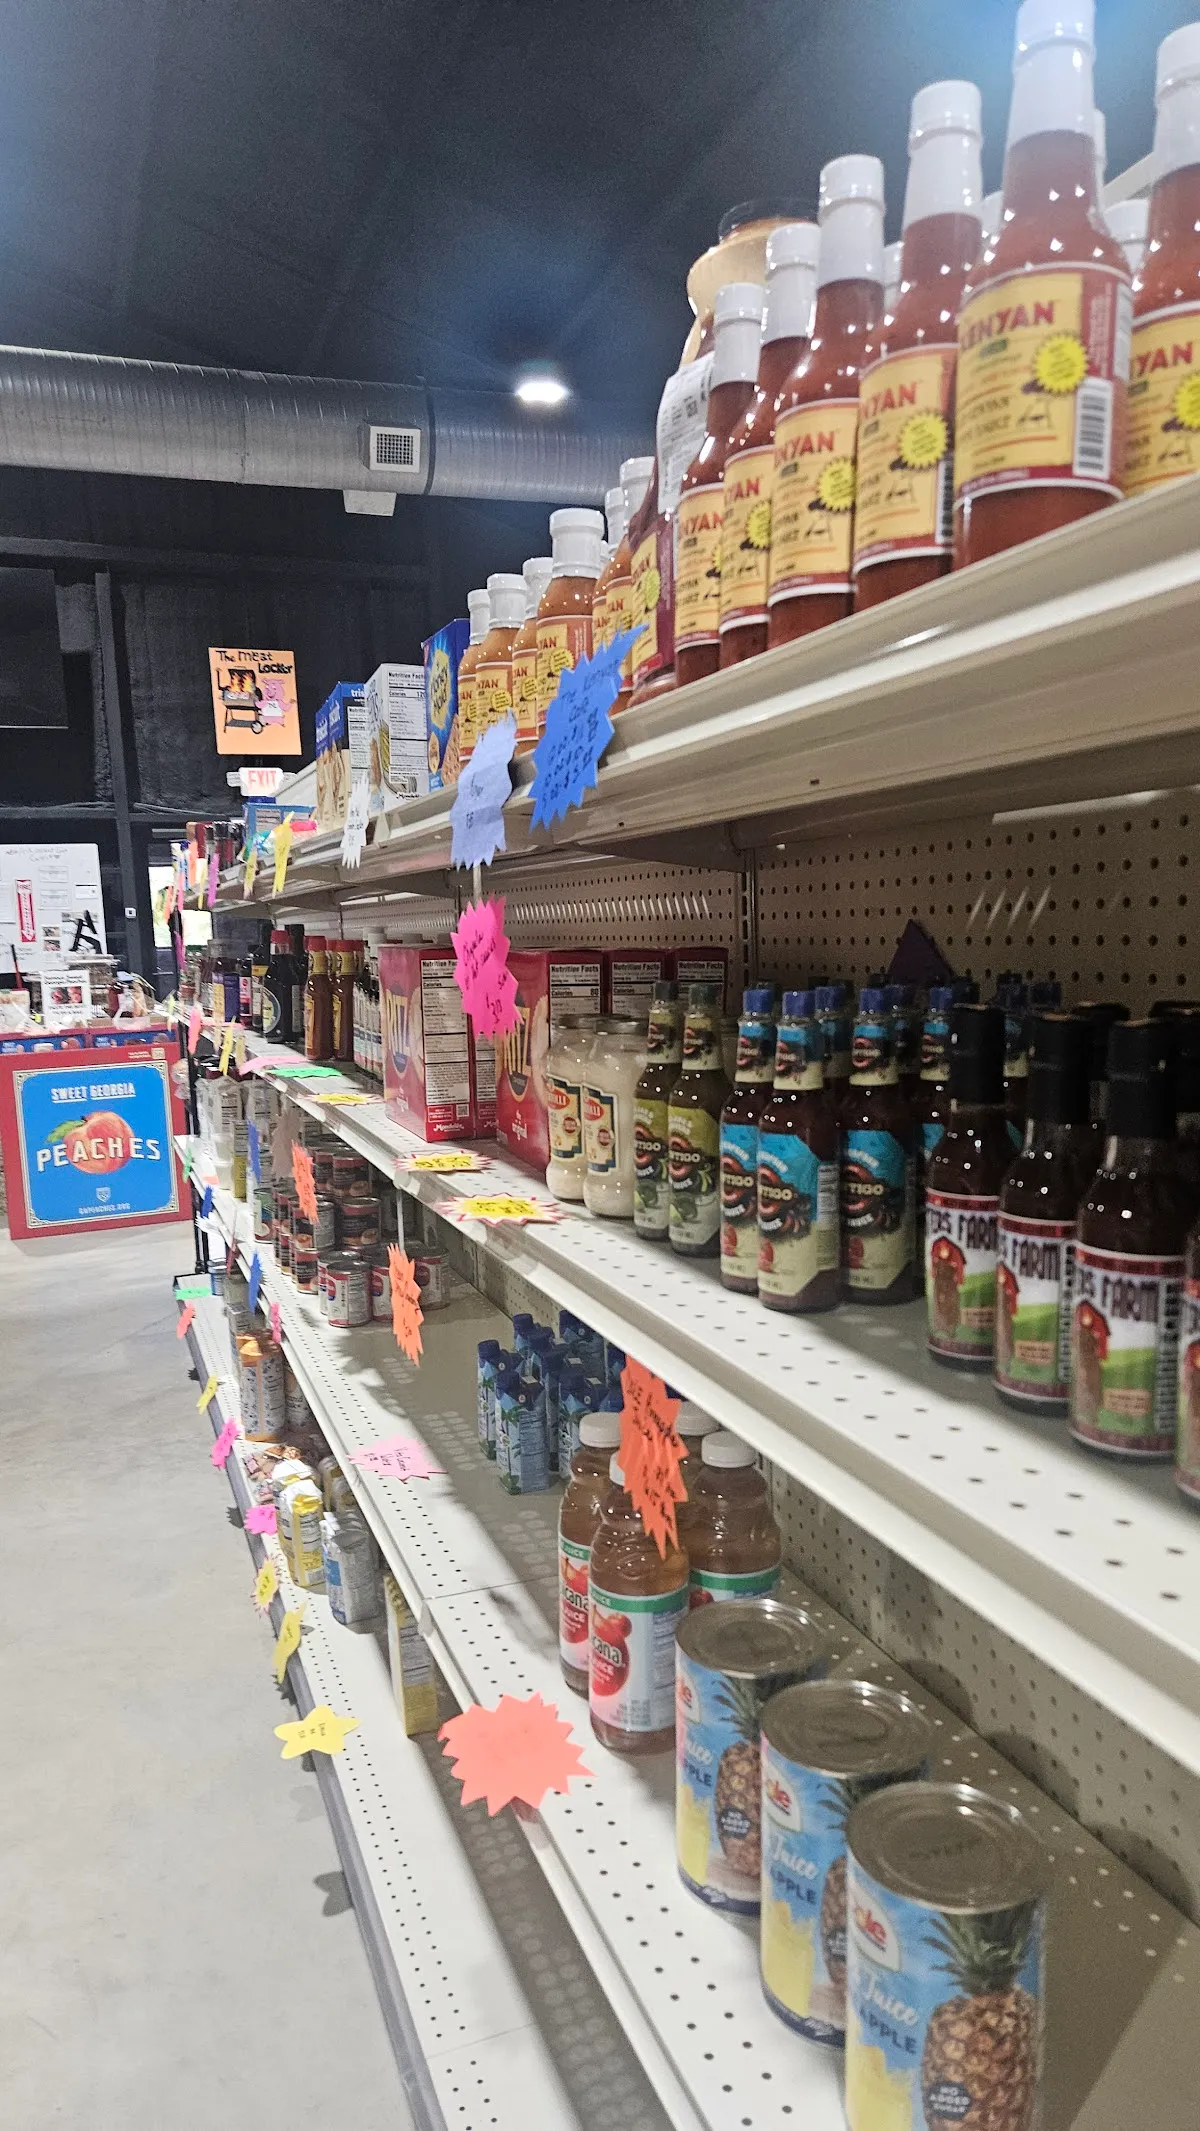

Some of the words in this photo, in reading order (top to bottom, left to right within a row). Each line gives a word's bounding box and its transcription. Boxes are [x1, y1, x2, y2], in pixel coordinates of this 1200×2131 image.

[247, 770, 277, 789] EXIT
[551, 965, 580, 974] Nutrition
[581, 964, 599, 973] Facts
[51, 1085, 88, 1101] SWEET
[90, 1083, 137, 1098] GEORGIA
[36, 1137, 162, 1173] PEACHES
